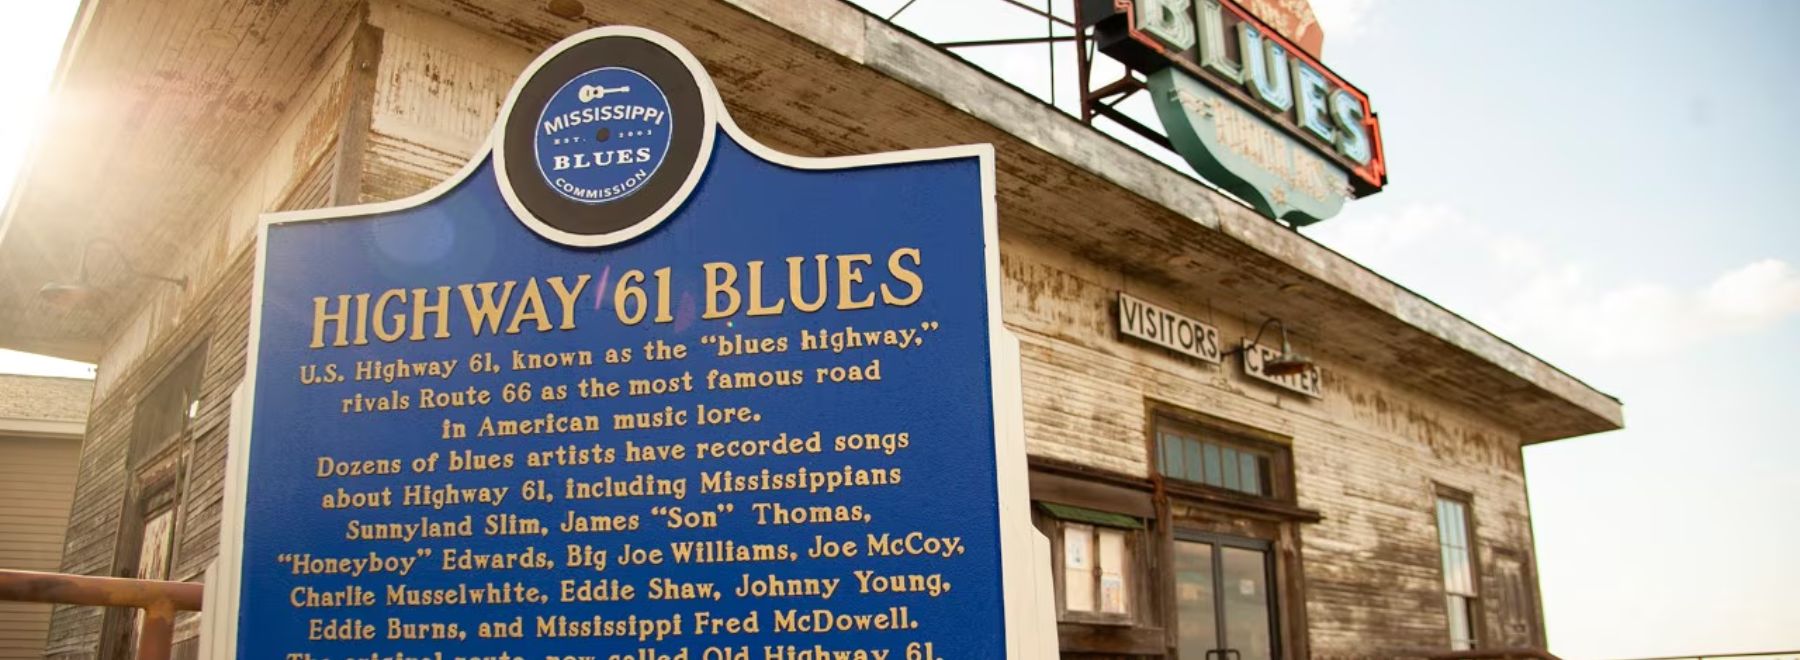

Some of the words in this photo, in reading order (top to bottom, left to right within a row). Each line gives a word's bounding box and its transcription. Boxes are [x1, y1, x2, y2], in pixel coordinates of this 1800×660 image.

[1135, 0, 1372, 166] BLUES
[543, 105, 665, 136] MISSISSIPPI
[553, 136, 587, 146] EST.
[553, 148, 651, 171] BLUES
[555, 169, 648, 199] COMMISSION
[309, 274, 592, 349] HIGHWAY
[612, 266, 674, 326] 61
[702, 246, 924, 321] BLUES
[299, 363, 346, 385] U.S.
[353, 357, 457, 384] Highway
[468, 351, 501, 374] 61,
[511, 350, 593, 371] known
[604, 347, 632, 364] as
[643, 339, 687, 361] the
[700, 333, 789, 357] “blues
[800, 321, 939, 354] highway,”
[1122, 296, 1218, 359] VISITORS
[1246, 345, 1320, 394] CEER
[341, 389, 410, 414] rivals
[418, 385, 491, 409] Route
[501, 381, 532, 404] 66
[540, 384, 568, 401] as
[577, 377, 621, 399] the
[628, 371, 693, 396] most
[706, 368, 804, 390] famous
[816, 359, 881, 384] road
[441, 418, 466, 440] in
[478, 413, 600, 438] American
[613, 406, 687, 431] music
[696, 404, 762, 426] lore.
[316, 456, 402, 478] Dozens
[411, 452, 440, 474] of
[448, 449, 514, 472] blues
[526, 443, 616, 468] artists
[625, 440, 685, 463] have
[696, 431, 822, 460] recorded
[834, 432, 910, 456] songs
[321, 487, 392, 509] about
[402, 484, 509, 510] Highway
[521, 479, 554, 503] 61,
[565, 474, 687, 500] including
[700, 465, 902, 494] Mississippians
[346, 515, 473, 543] Sunnyland
[484, 513, 549, 537] Slim,
[560, 510, 640, 533] James
[651, 503, 734, 529] “Son”
[752, 502, 872, 526] Thomas,
[277, 548, 432, 577] “Honeyboy”
[442, 546, 554, 571] Edwards,
[566, 543, 607, 572] Big
[617, 543, 663, 566] Joe
[670, 540, 798, 564] Williams,
[807, 535, 858, 559] Joe
[867, 531, 965, 558] McCoy,
[290, 585, 375, 608] Charlie
[386, 583, 549, 606] Musselwhite,
[560, 578, 634, 603] Eddie
[648, 578, 721, 601] Shaw,
[735, 574, 839, 600] Johnny
[854, 570, 951, 597] Young,
[309, 619, 375, 641] Eddie
[387, 618, 466, 640] Burns,
[478, 617, 523, 638] and
[536, 614, 682, 642] Mississippi
[694, 610, 759, 635] Fred
[774, 606, 918, 633] McDowell.
[702, 645, 749, 660] Old
